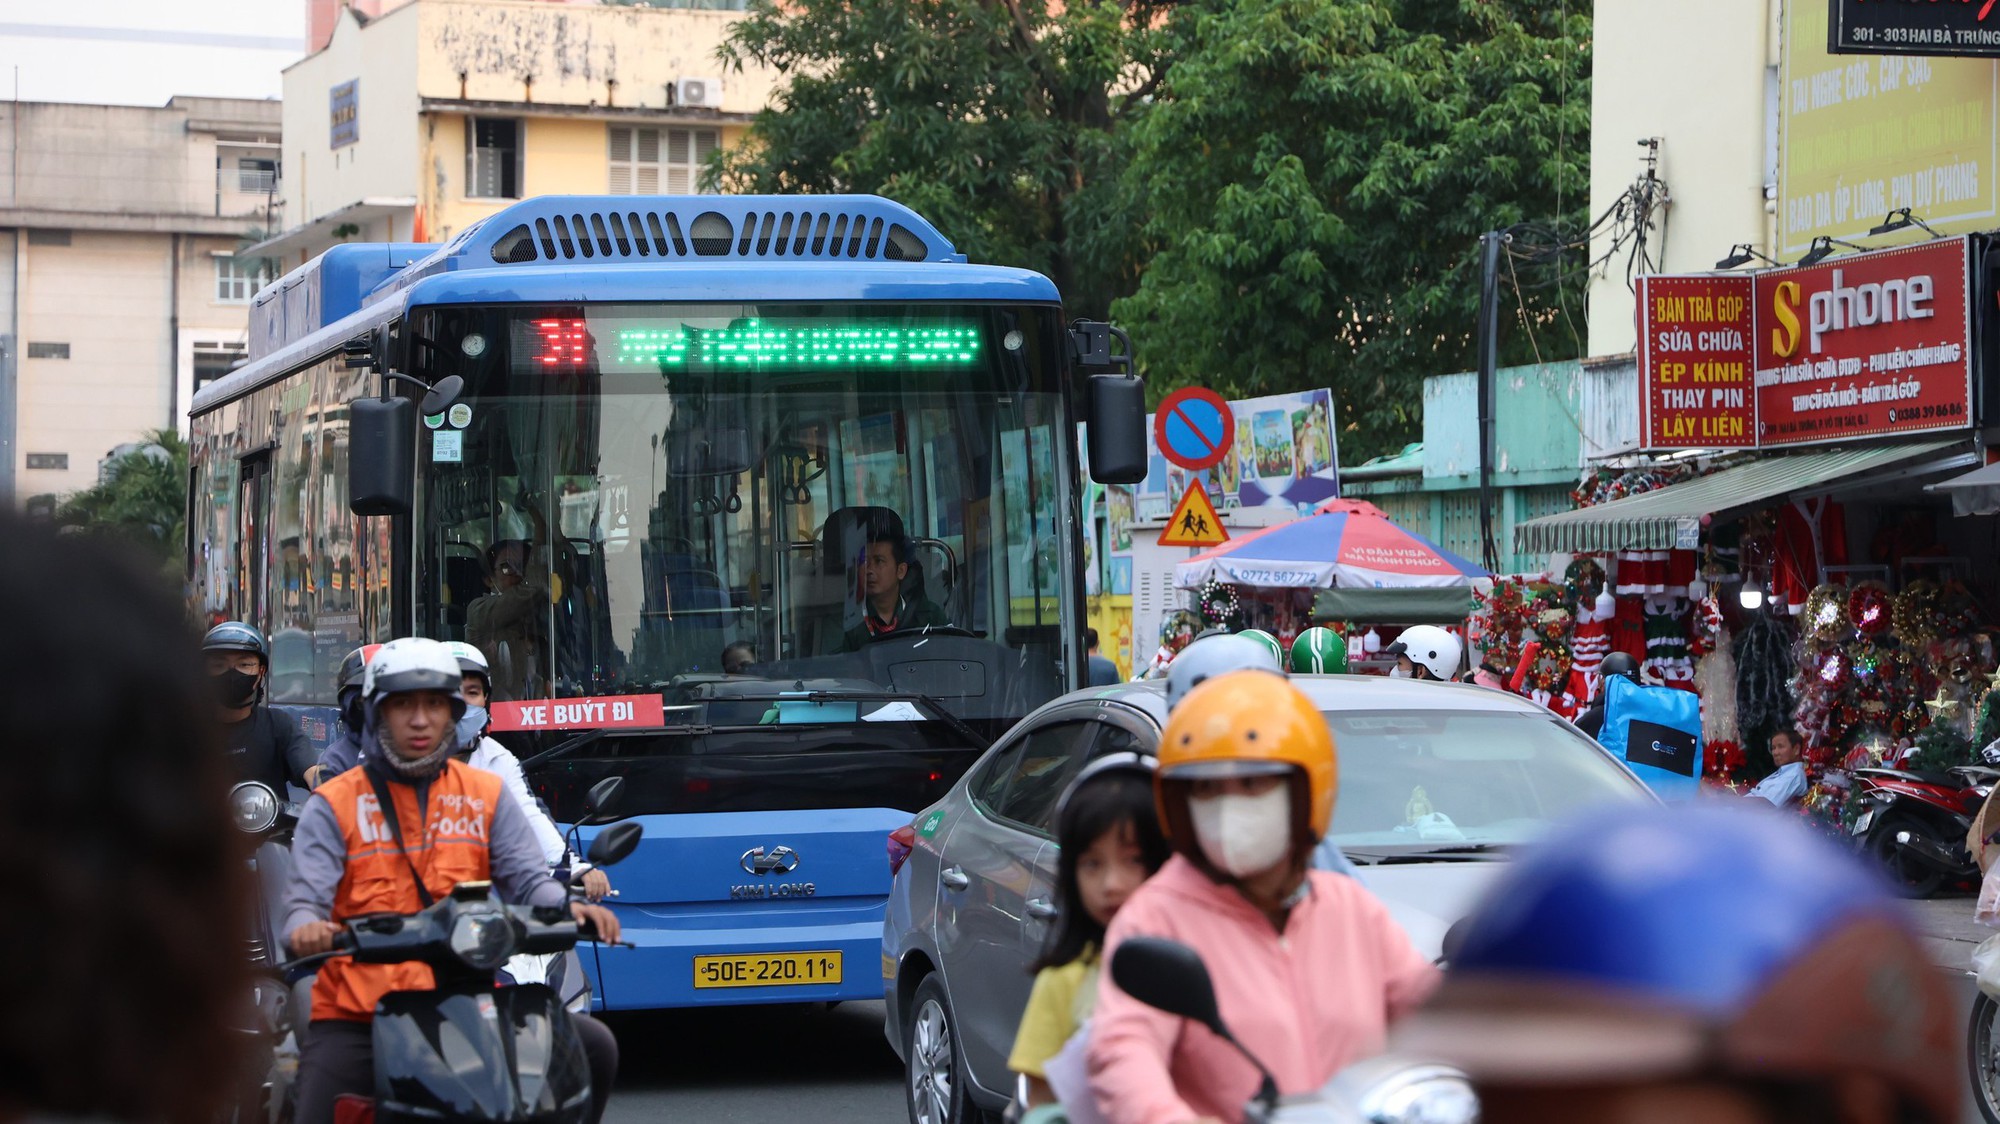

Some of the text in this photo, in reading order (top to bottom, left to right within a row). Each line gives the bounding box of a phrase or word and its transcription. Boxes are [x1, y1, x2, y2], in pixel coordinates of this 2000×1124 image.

[1853, 27, 1874, 42] 301
[1884, 28, 1907, 42] 303
[1909, 29, 1931, 43] HAI
[1933, 24, 1952, 44] BÀ
[1955, 29, 2000, 45] TRƯNG
[1792, 77, 1808, 115] TAI
[1811, 68, 1842, 109] NGHE
[1789, 195, 1812, 234] BAO
[1816, 192, 1832, 228] DA
[1936, 154, 1978, 204] PHÒNG
[1657, 287, 1743, 323] BÁN TRẢ GÓP
[1772, 269, 1934, 358] S phone
[1658, 325, 1743, 352] SỬA CHỮA
[1660, 358, 1743, 383] ÉP KÍNH
[1887, 347, 1906, 373] KIỆN
[1661, 388, 1743, 409] THAY PIN
[1899, 375, 1921, 399] GÓP
[1663, 410, 1743, 438] LẤY LIỀN
[1395, 549, 1426, 557] VISA
[1405, 557, 1442, 567] PHÚC
[1241, 570, 1270, 581] 0772
[1273, 571, 1295, 582] 567
[520, 700, 634, 726] XE BUÝT ĐI
[730, 882, 816, 899] KIM LONG
[707, 958, 827, 982] 50E-220.11
